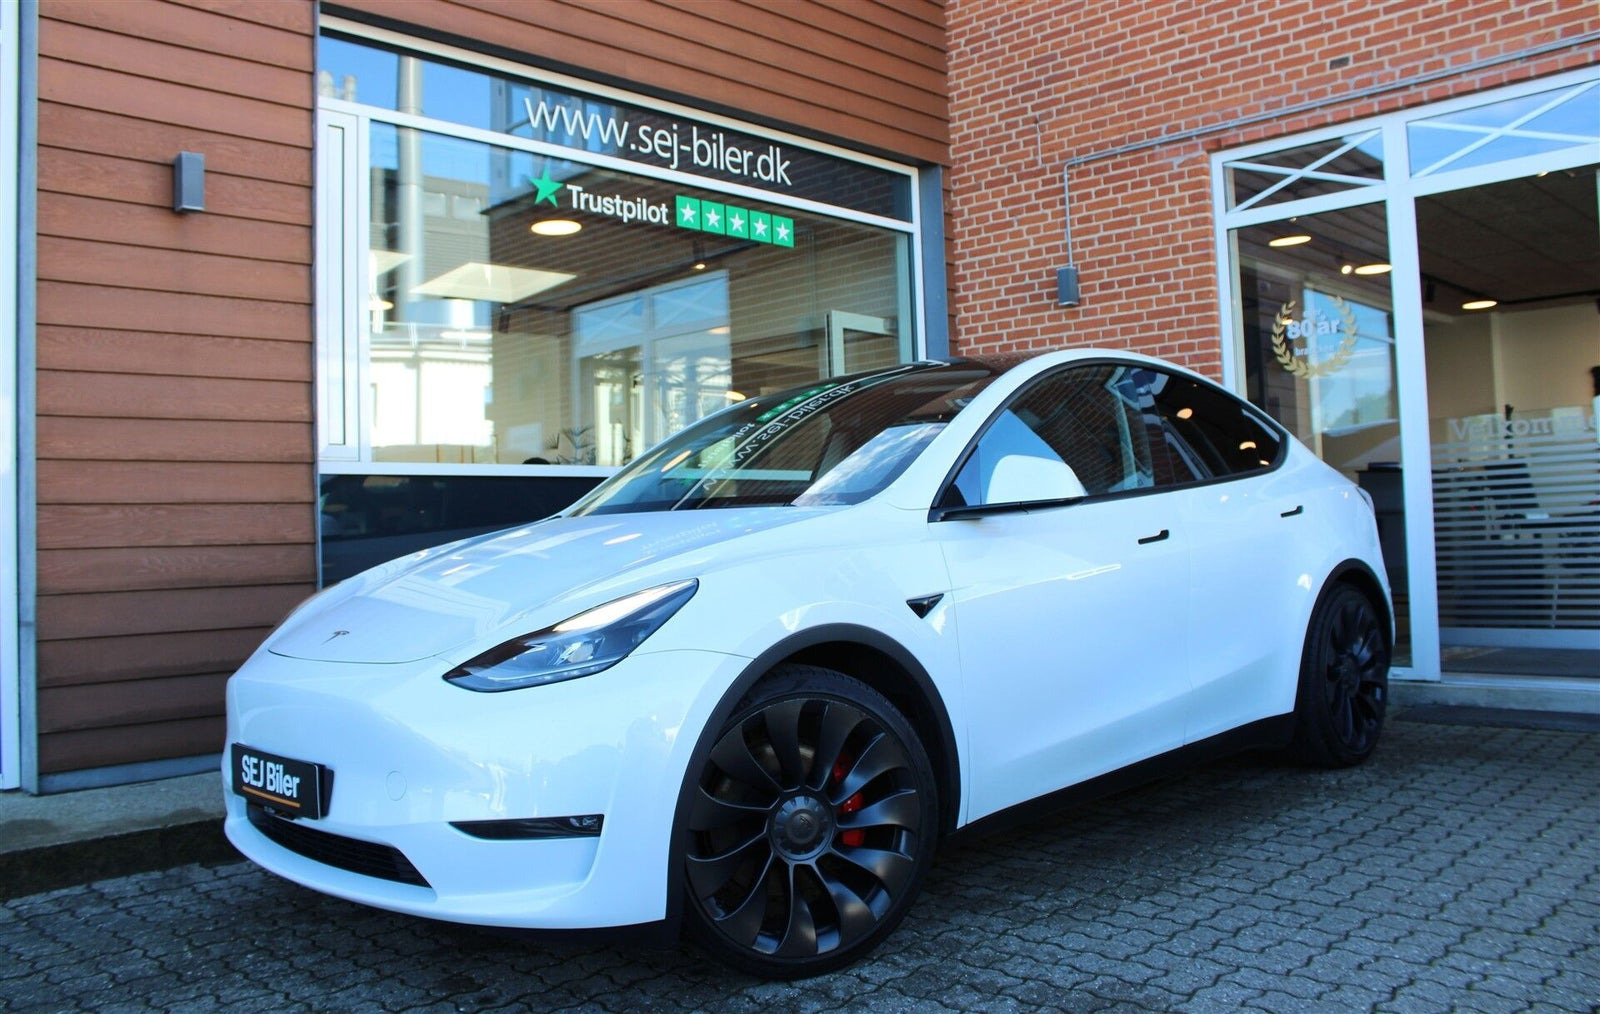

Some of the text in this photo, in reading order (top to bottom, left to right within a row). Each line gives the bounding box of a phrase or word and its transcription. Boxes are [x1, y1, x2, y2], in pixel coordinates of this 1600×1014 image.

[524, 97, 793, 186] www.sej-biler.dk
[566, 184, 669, 225] Trustpilot
[1286, 319, 1314, 340] 80
[241, 754, 300, 798] SEJ Biler
